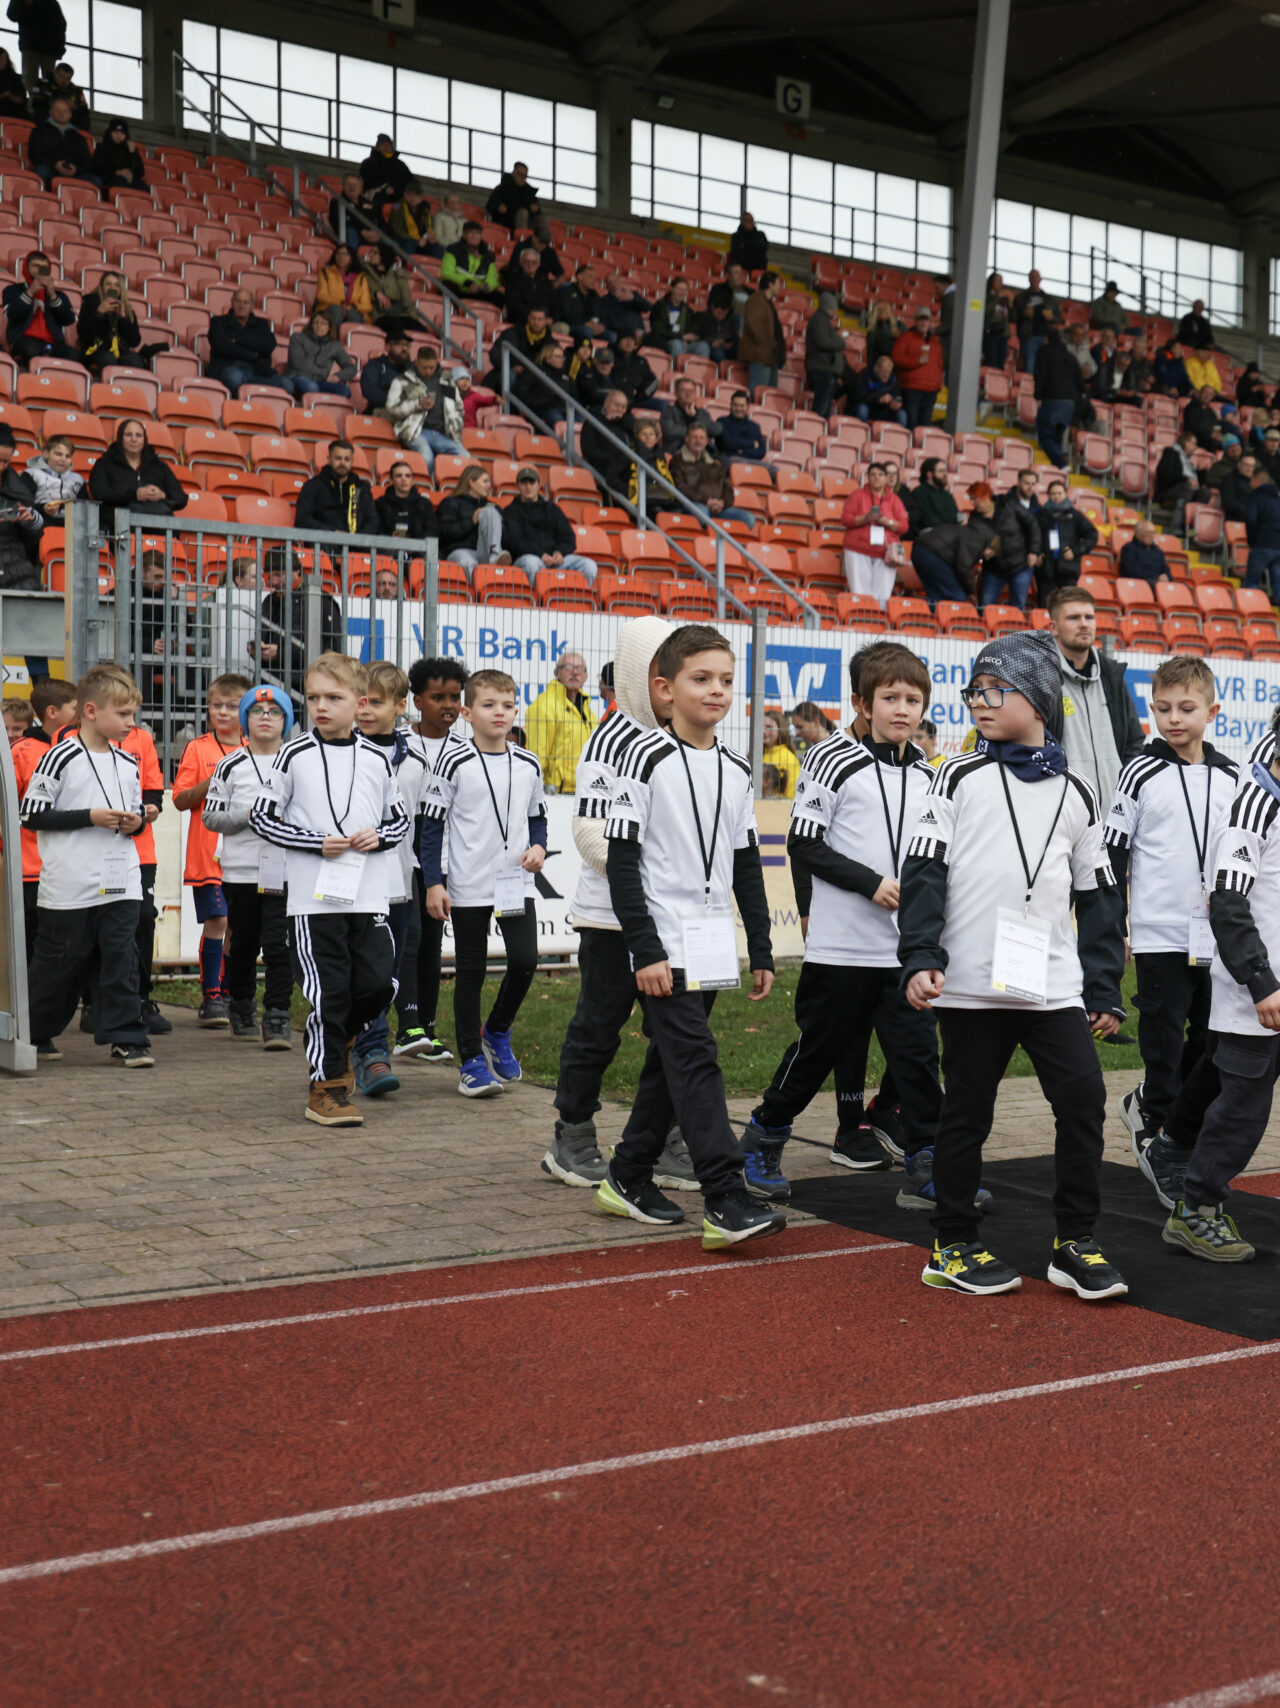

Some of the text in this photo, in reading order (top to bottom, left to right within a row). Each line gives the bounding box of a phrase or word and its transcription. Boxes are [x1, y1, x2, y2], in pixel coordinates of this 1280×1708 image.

[782, 83, 801, 113] G
[478, 627, 570, 662] Bank
[1214, 676, 1246, 701] VR
